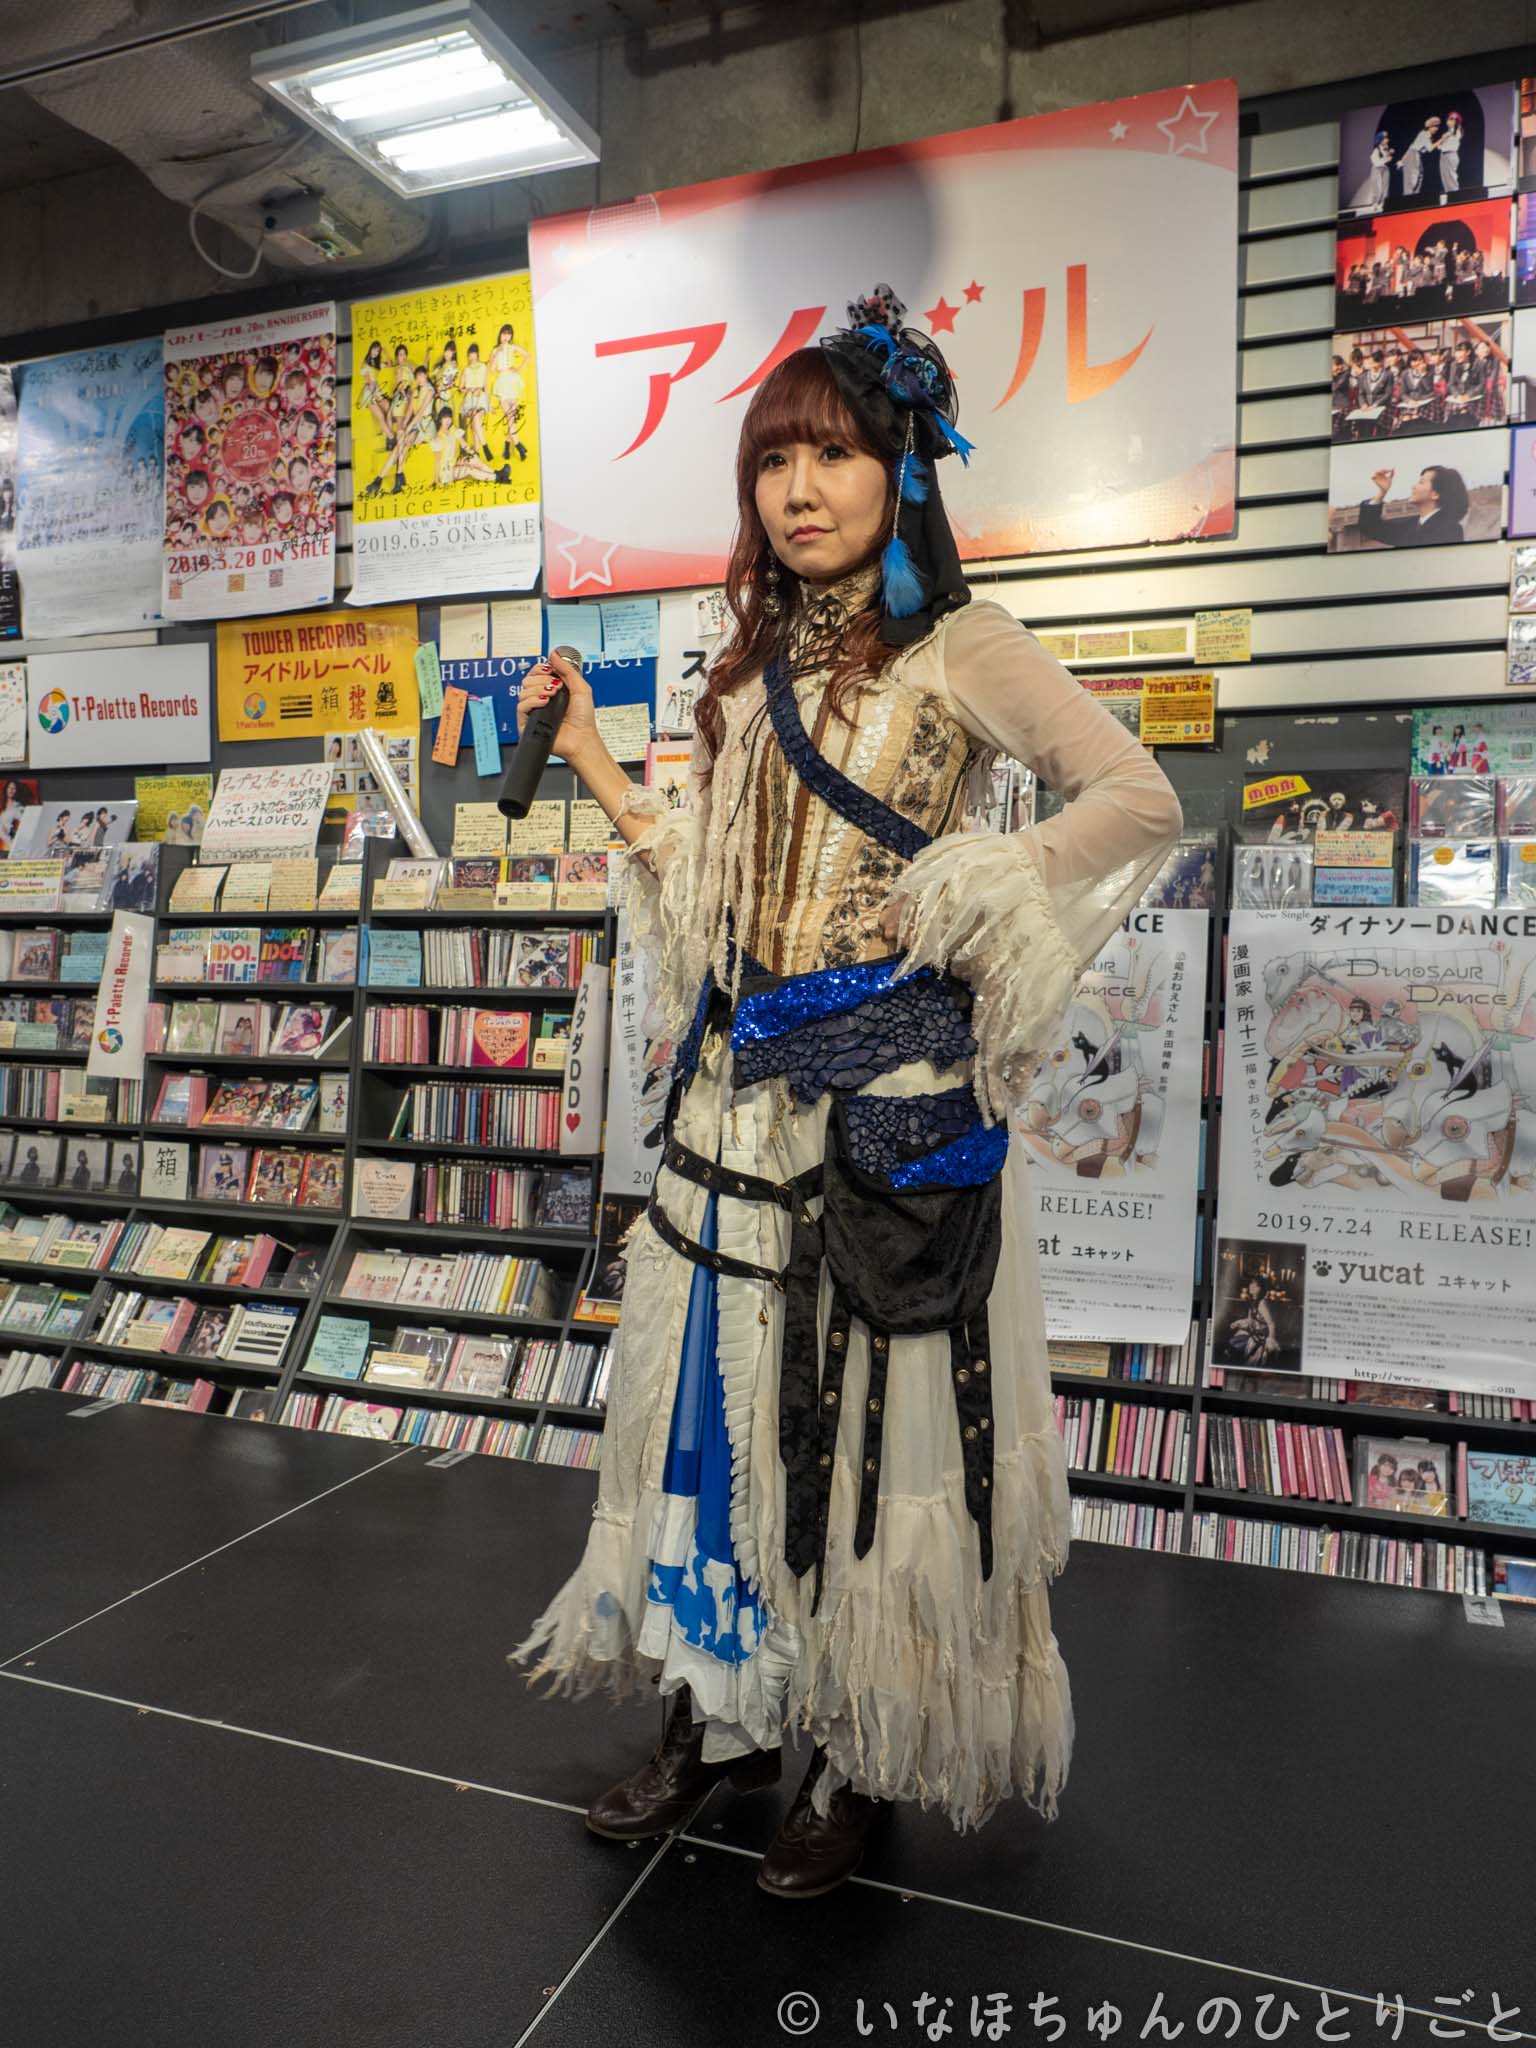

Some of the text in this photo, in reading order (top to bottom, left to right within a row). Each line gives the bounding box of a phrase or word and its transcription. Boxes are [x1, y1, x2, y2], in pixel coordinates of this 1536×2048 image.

[595, 263, 1157, 460] アイル
[400, 511, 489, 531] New Single
[357, 530, 440, 555] 2019.6.5
[481, 518, 536, 542] SALE
[262, 548, 285, 566] ON
[290, 537, 330, 561] SALE
[242, 622, 368, 657] TOWER RECORDS
[243, 653, 392, 685] アイドルレーベル
[440, 658, 516, 681] HELLO
[72, 691, 199, 723] T-Palette Records
[1256, 909, 1311, 921] New Single
[1310, 914, 1536, 937] ダイナソーDANCE
[210, 943, 257, 962] IDOL
[261, 943, 305, 961] IDOL
[106, 935, 134, 1026] T-Palette Records
[208, 963, 257, 982] FILE
[259, 961, 304, 981] FILE
[1231, 944, 1264, 1183] 漫画家 所十三 描きおろしイラスト
[156, 1147, 177, 1177] 箱
[1040, 1195, 1153, 1220] RELEASE!
[1256, 1211, 1373, 1237] 2019.7.24
[1399, 1219, 1532, 1248] RELEASE!
[1071, 1245, 1135, 1262] ユキャット
[1338, 1261, 1512, 1293] yucat ユキャット
